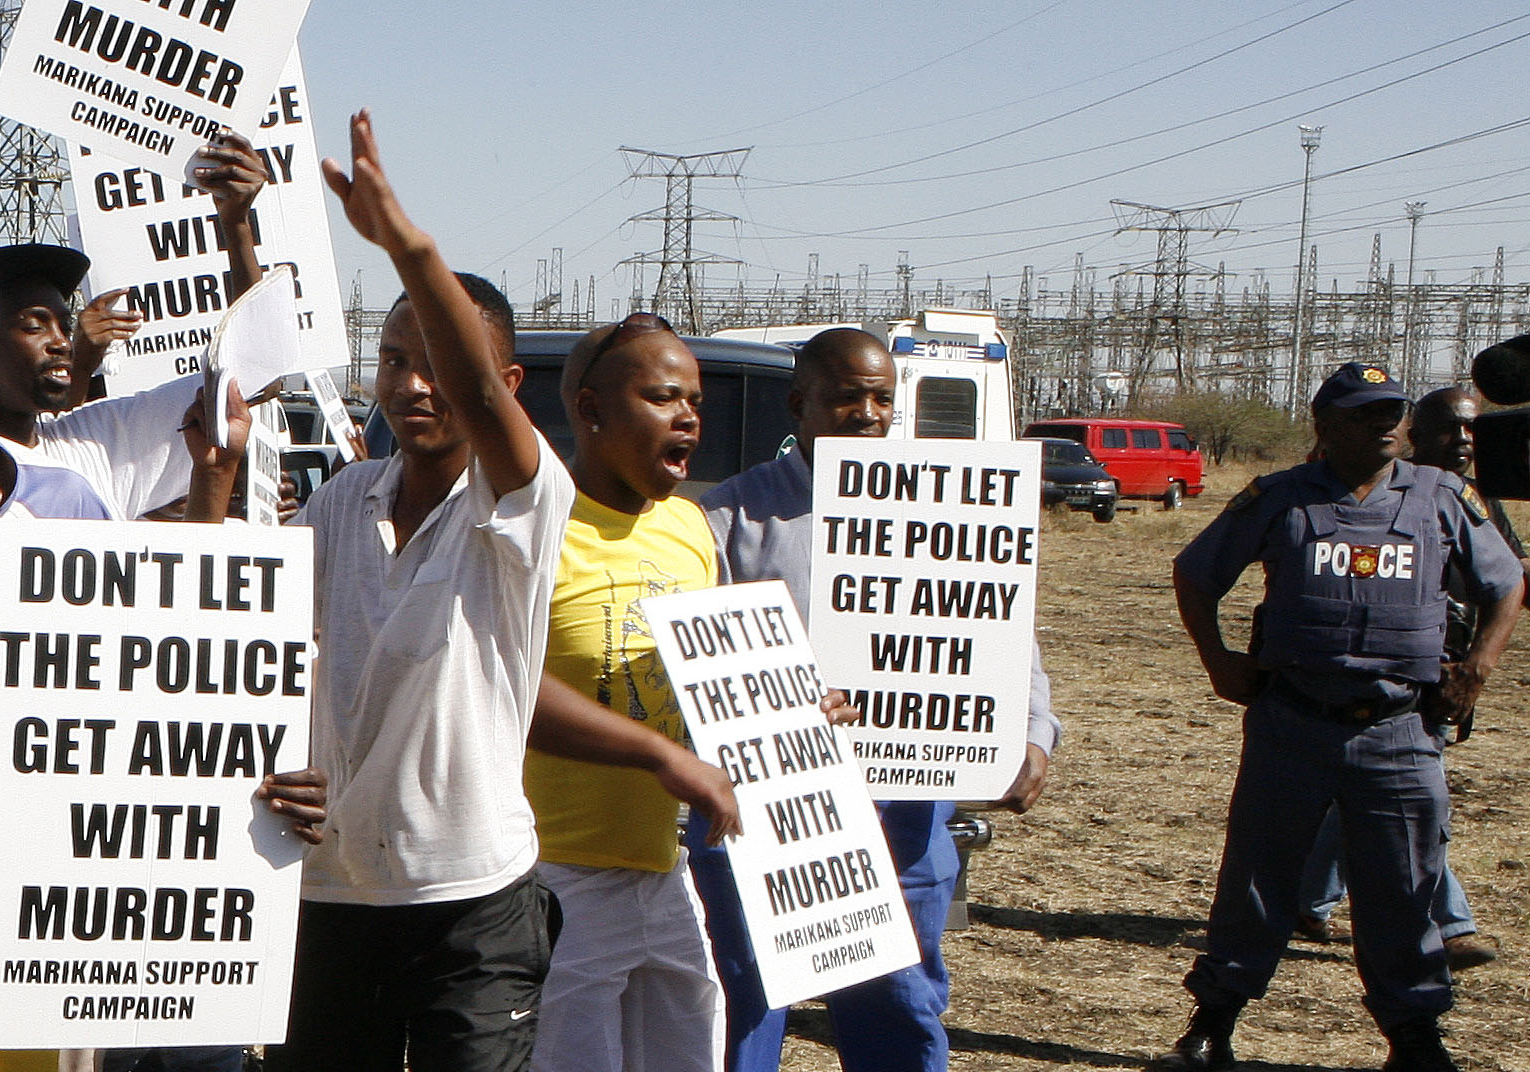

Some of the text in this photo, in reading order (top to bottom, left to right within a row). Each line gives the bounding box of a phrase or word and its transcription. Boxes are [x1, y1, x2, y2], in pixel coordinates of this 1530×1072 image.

[33, 54, 139, 111] MARIKANA
[54, 1, 244, 109] MURDER
[71, 100, 175, 156] CAMPAIGN
[125, 326, 218, 357] MARIKAN
[837, 460, 1020, 507] DON'T LET
[822, 516, 1034, 565] THE POLICE
[19, 546, 284, 612] DON'T LET
[831, 574, 1019, 621] GET AWAY
[670, 605, 793, 661] DON'T LET
[870, 633, 973, 676] WITH
[118, 636, 306, 696] POLICE
[684, 662, 826, 725] THE POLICE
[12, 717, 288, 778] GET AWAY
[718, 724, 844, 786] GET AWAY
[854, 741, 999, 764] RIKANA SUPPORT
[866, 767, 956, 787] CAMPAIGN
[69, 803, 221, 860] WITH
[765, 790, 842, 846] WITH
[764, 848, 879, 916] MURDER
[17, 886, 255, 942] MURDER
[774, 902, 892, 954] MARIKANA SUPPORT
[3, 960, 259, 985] MARIKANA SUPPORT
[811, 940, 875, 973] CAMPAIGN
[62, 996, 195, 1020] CAMPAIGN
